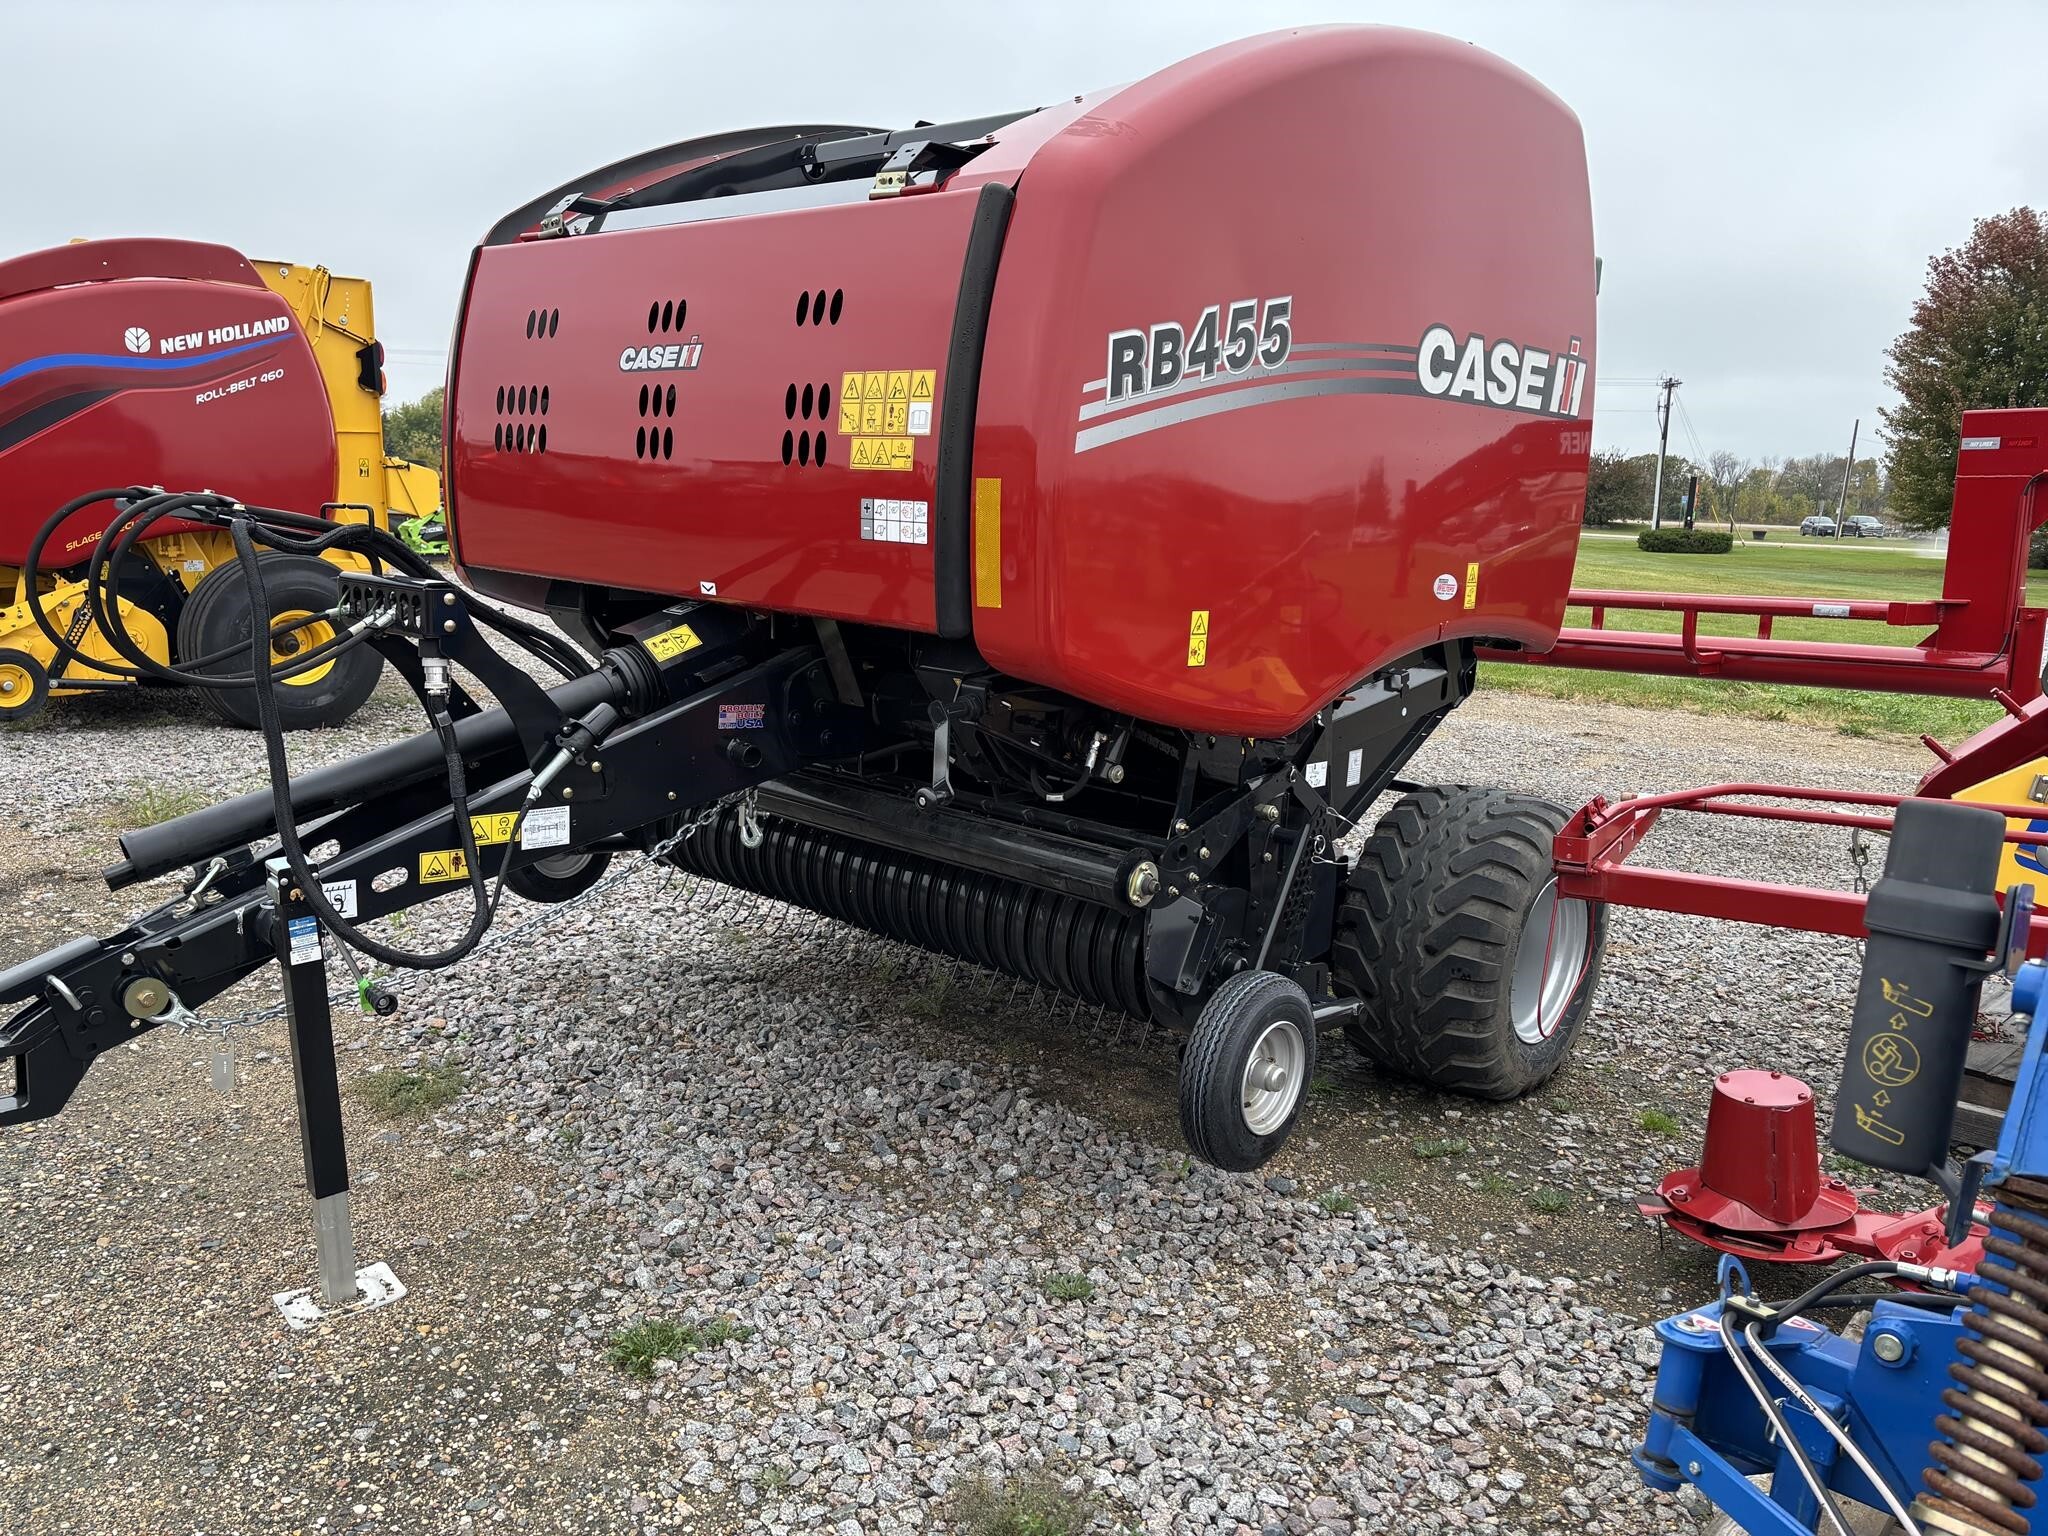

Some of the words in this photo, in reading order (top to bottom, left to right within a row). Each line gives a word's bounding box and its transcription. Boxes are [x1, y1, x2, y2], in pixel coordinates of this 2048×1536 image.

[160, 332, 203, 355] NEW
[208, 316, 290, 345] HOLLAND
[1105, 296, 1292, 405] RB455
[195, 377, 257, 404] ROLL-BELT
[260, 368, 284, 383] 460
[65, 531, 102, 552] SILAGE
[719, 704, 765, 712] PROUDLY
[736, 719, 764, 728] USA
